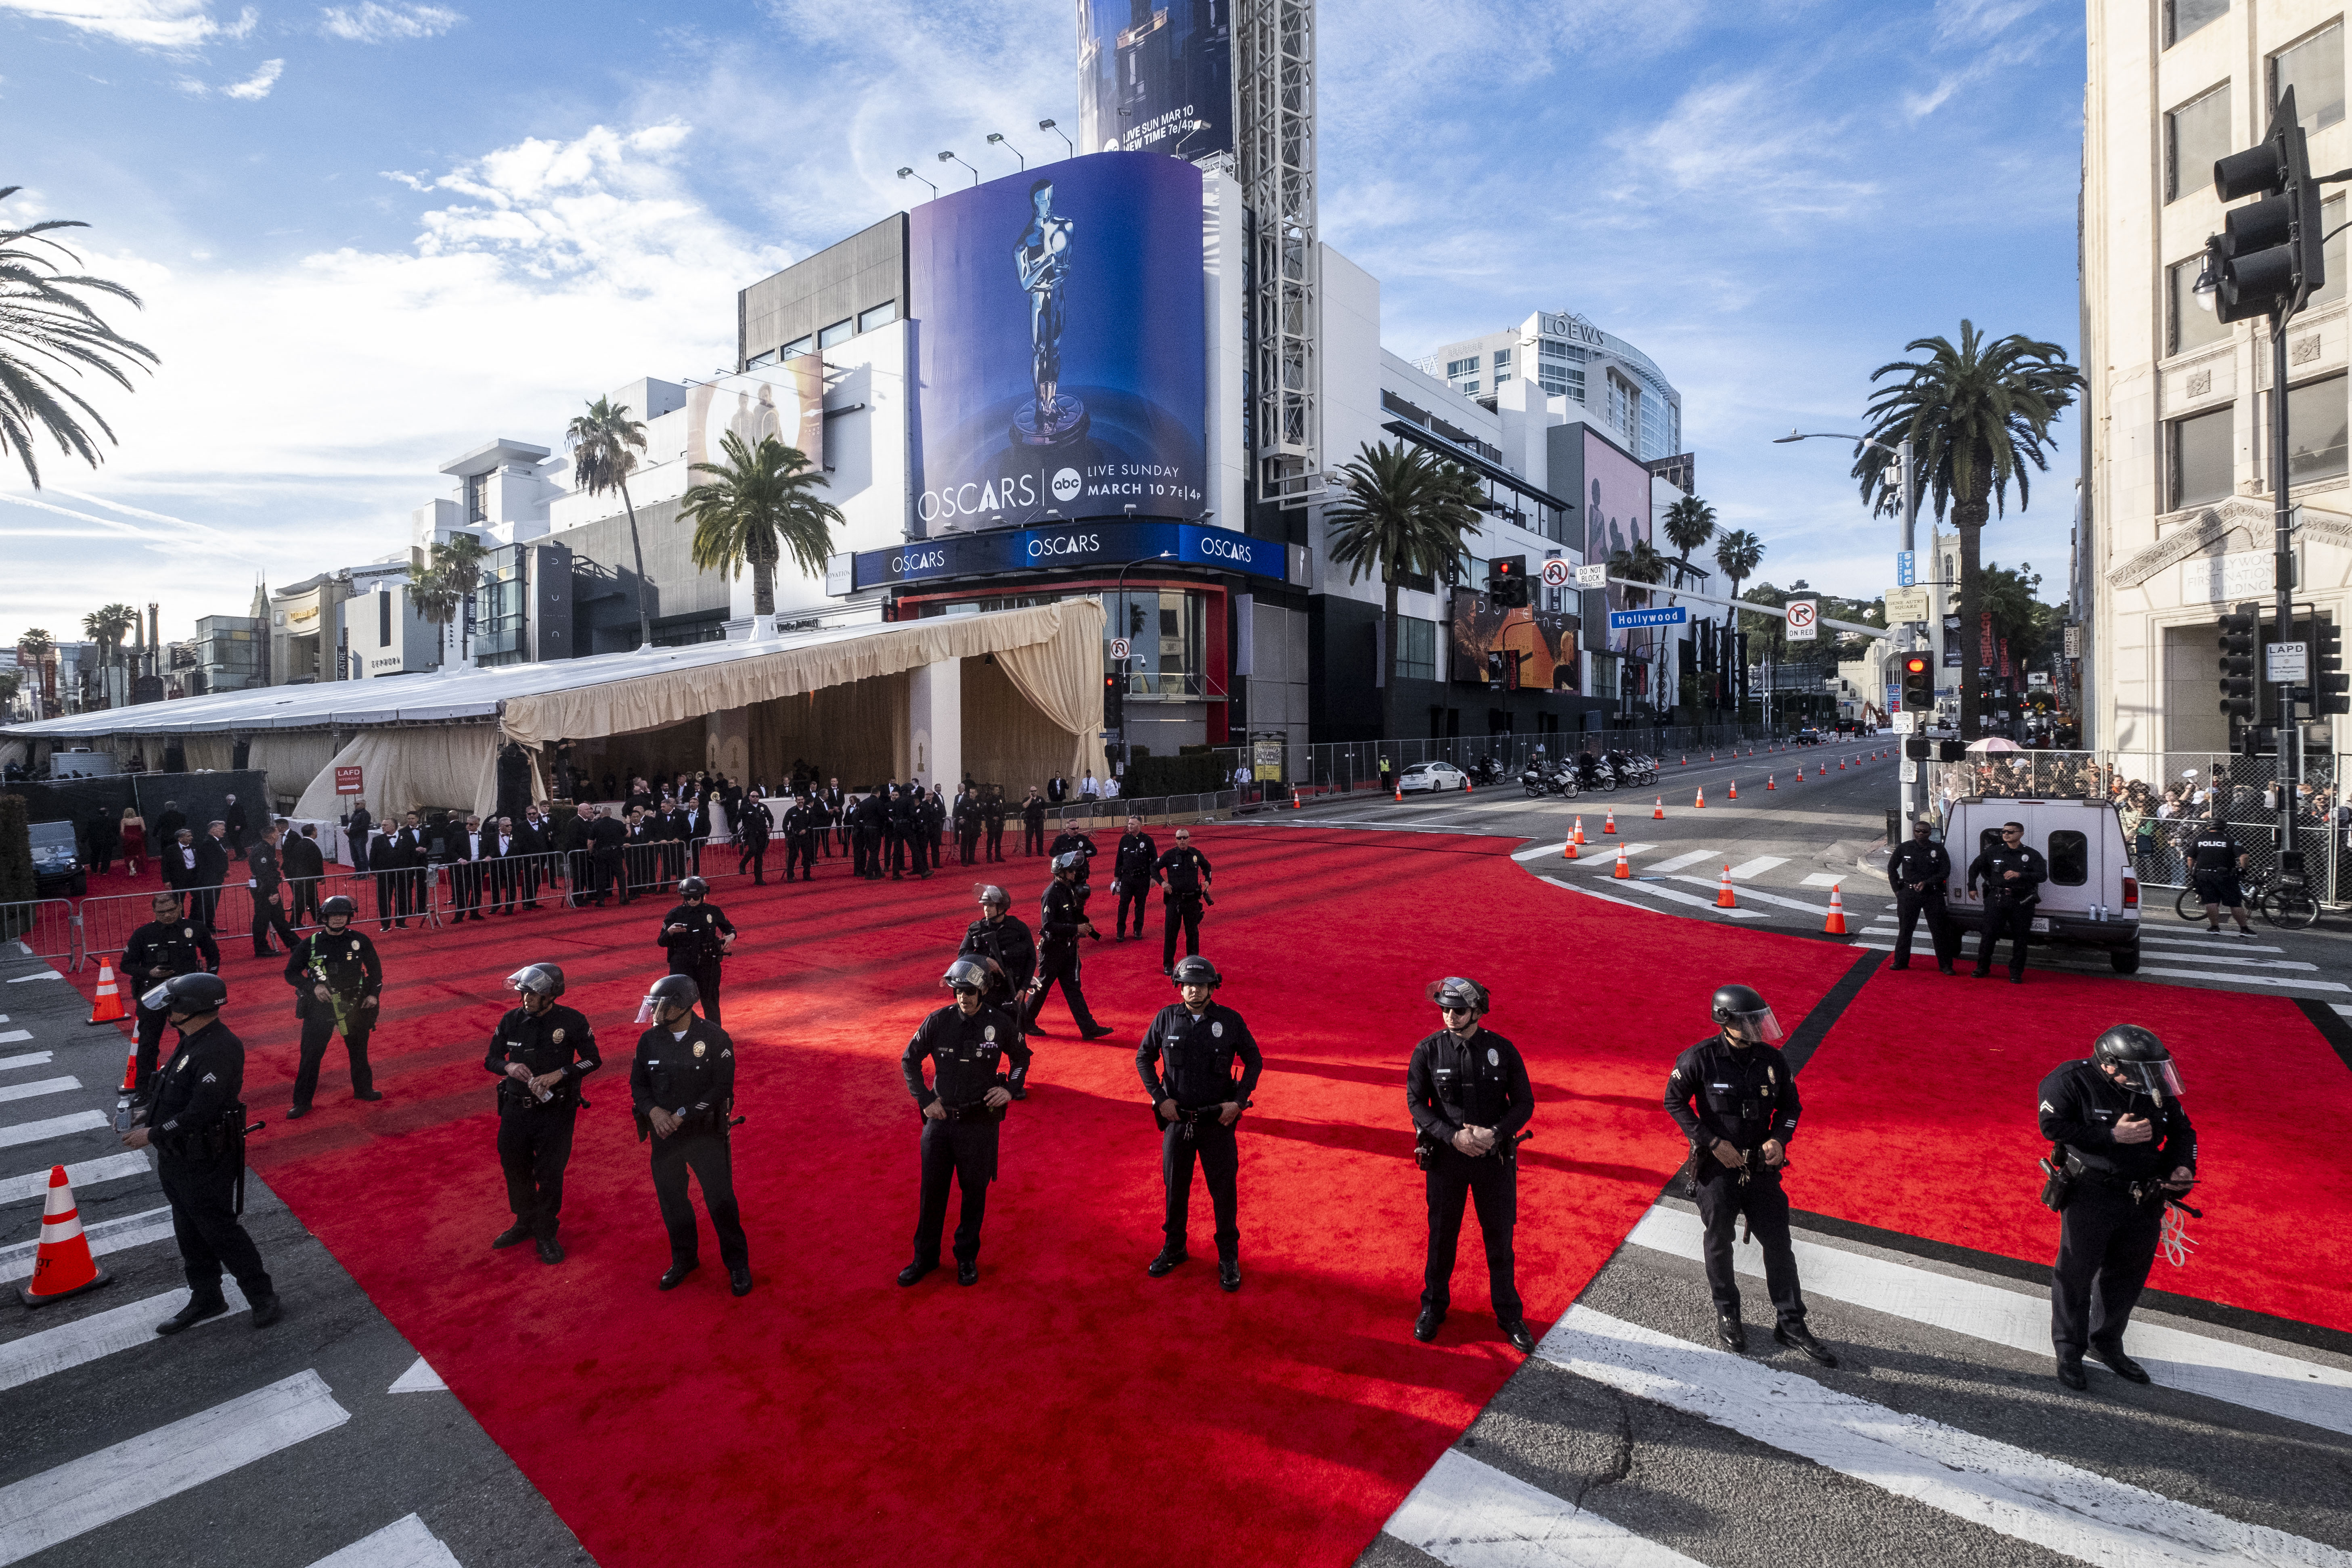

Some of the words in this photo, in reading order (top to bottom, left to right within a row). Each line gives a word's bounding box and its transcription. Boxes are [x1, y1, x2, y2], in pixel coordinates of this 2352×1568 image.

[1123, 126, 1140, 144] LIVE
[1142, 117, 1158, 134] SUN
[1161, 109, 1181, 126] MAR
[1183, 105, 1193, 117] 10
[1123, 137, 1142, 152] NEW
[1144, 126, 1166, 145] TIME
[1545, 316, 1604, 346] LOEWS
[1088, 465, 1115, 477] LIVE
[1121, 464, 1179, 477] SUNDAY
[1054, 477, 1079, 490] abc
[1087, 484, 1141, 496] MARCH
[1150, 484, 1164, 495] 10
[918, 474, 1035, 521] OSCARS
[1029, 534, 1100, 557] OSCARS
[1202, 537, 1251, 563] OSCARS
[892, 551, 945, 573] OSCARS
[2197, 553, 2274, 573] HOLLYWOO
[2188, 574, 2219, 587] FIRST
[2225, 567, 2275, 582] NATION
[1619, 611, 1678, 624] Hollywood
[1981, 612, 1993, 666] CHICAGO
[2269, 645, 2303, 653] LAPD
[38, 1258, 53, 1268] OT
